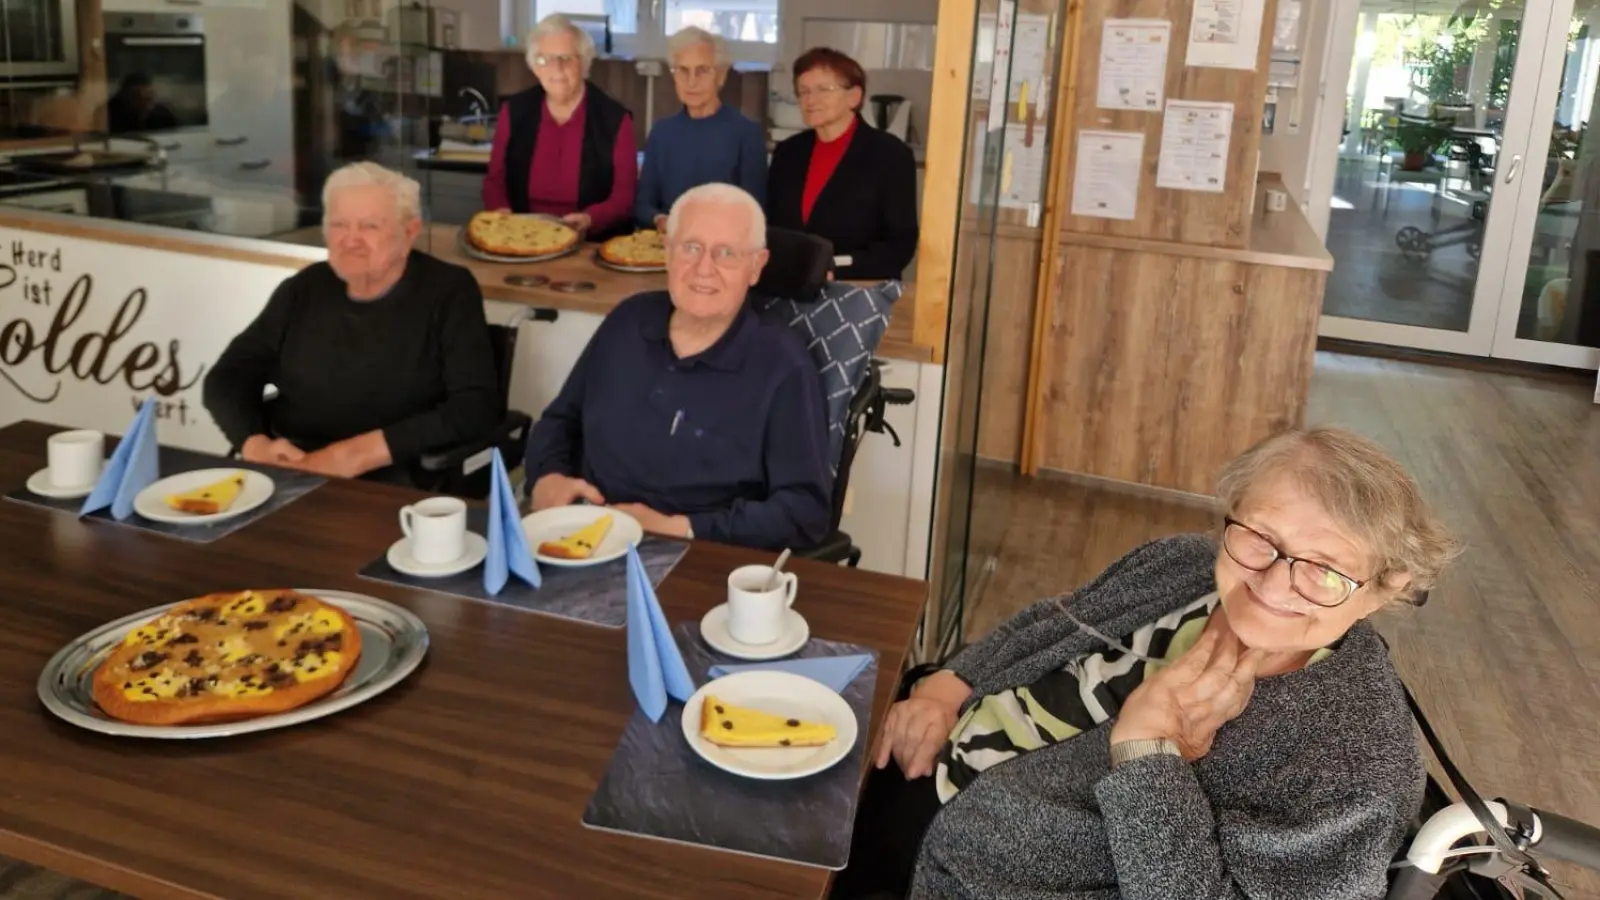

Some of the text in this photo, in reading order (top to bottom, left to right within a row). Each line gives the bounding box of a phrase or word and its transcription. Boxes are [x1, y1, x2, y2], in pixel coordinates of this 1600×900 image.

[12, 240, 61, 272] Herd
[24, 275, 53, 306] ist
[0, 272, 205, 397] oldes
